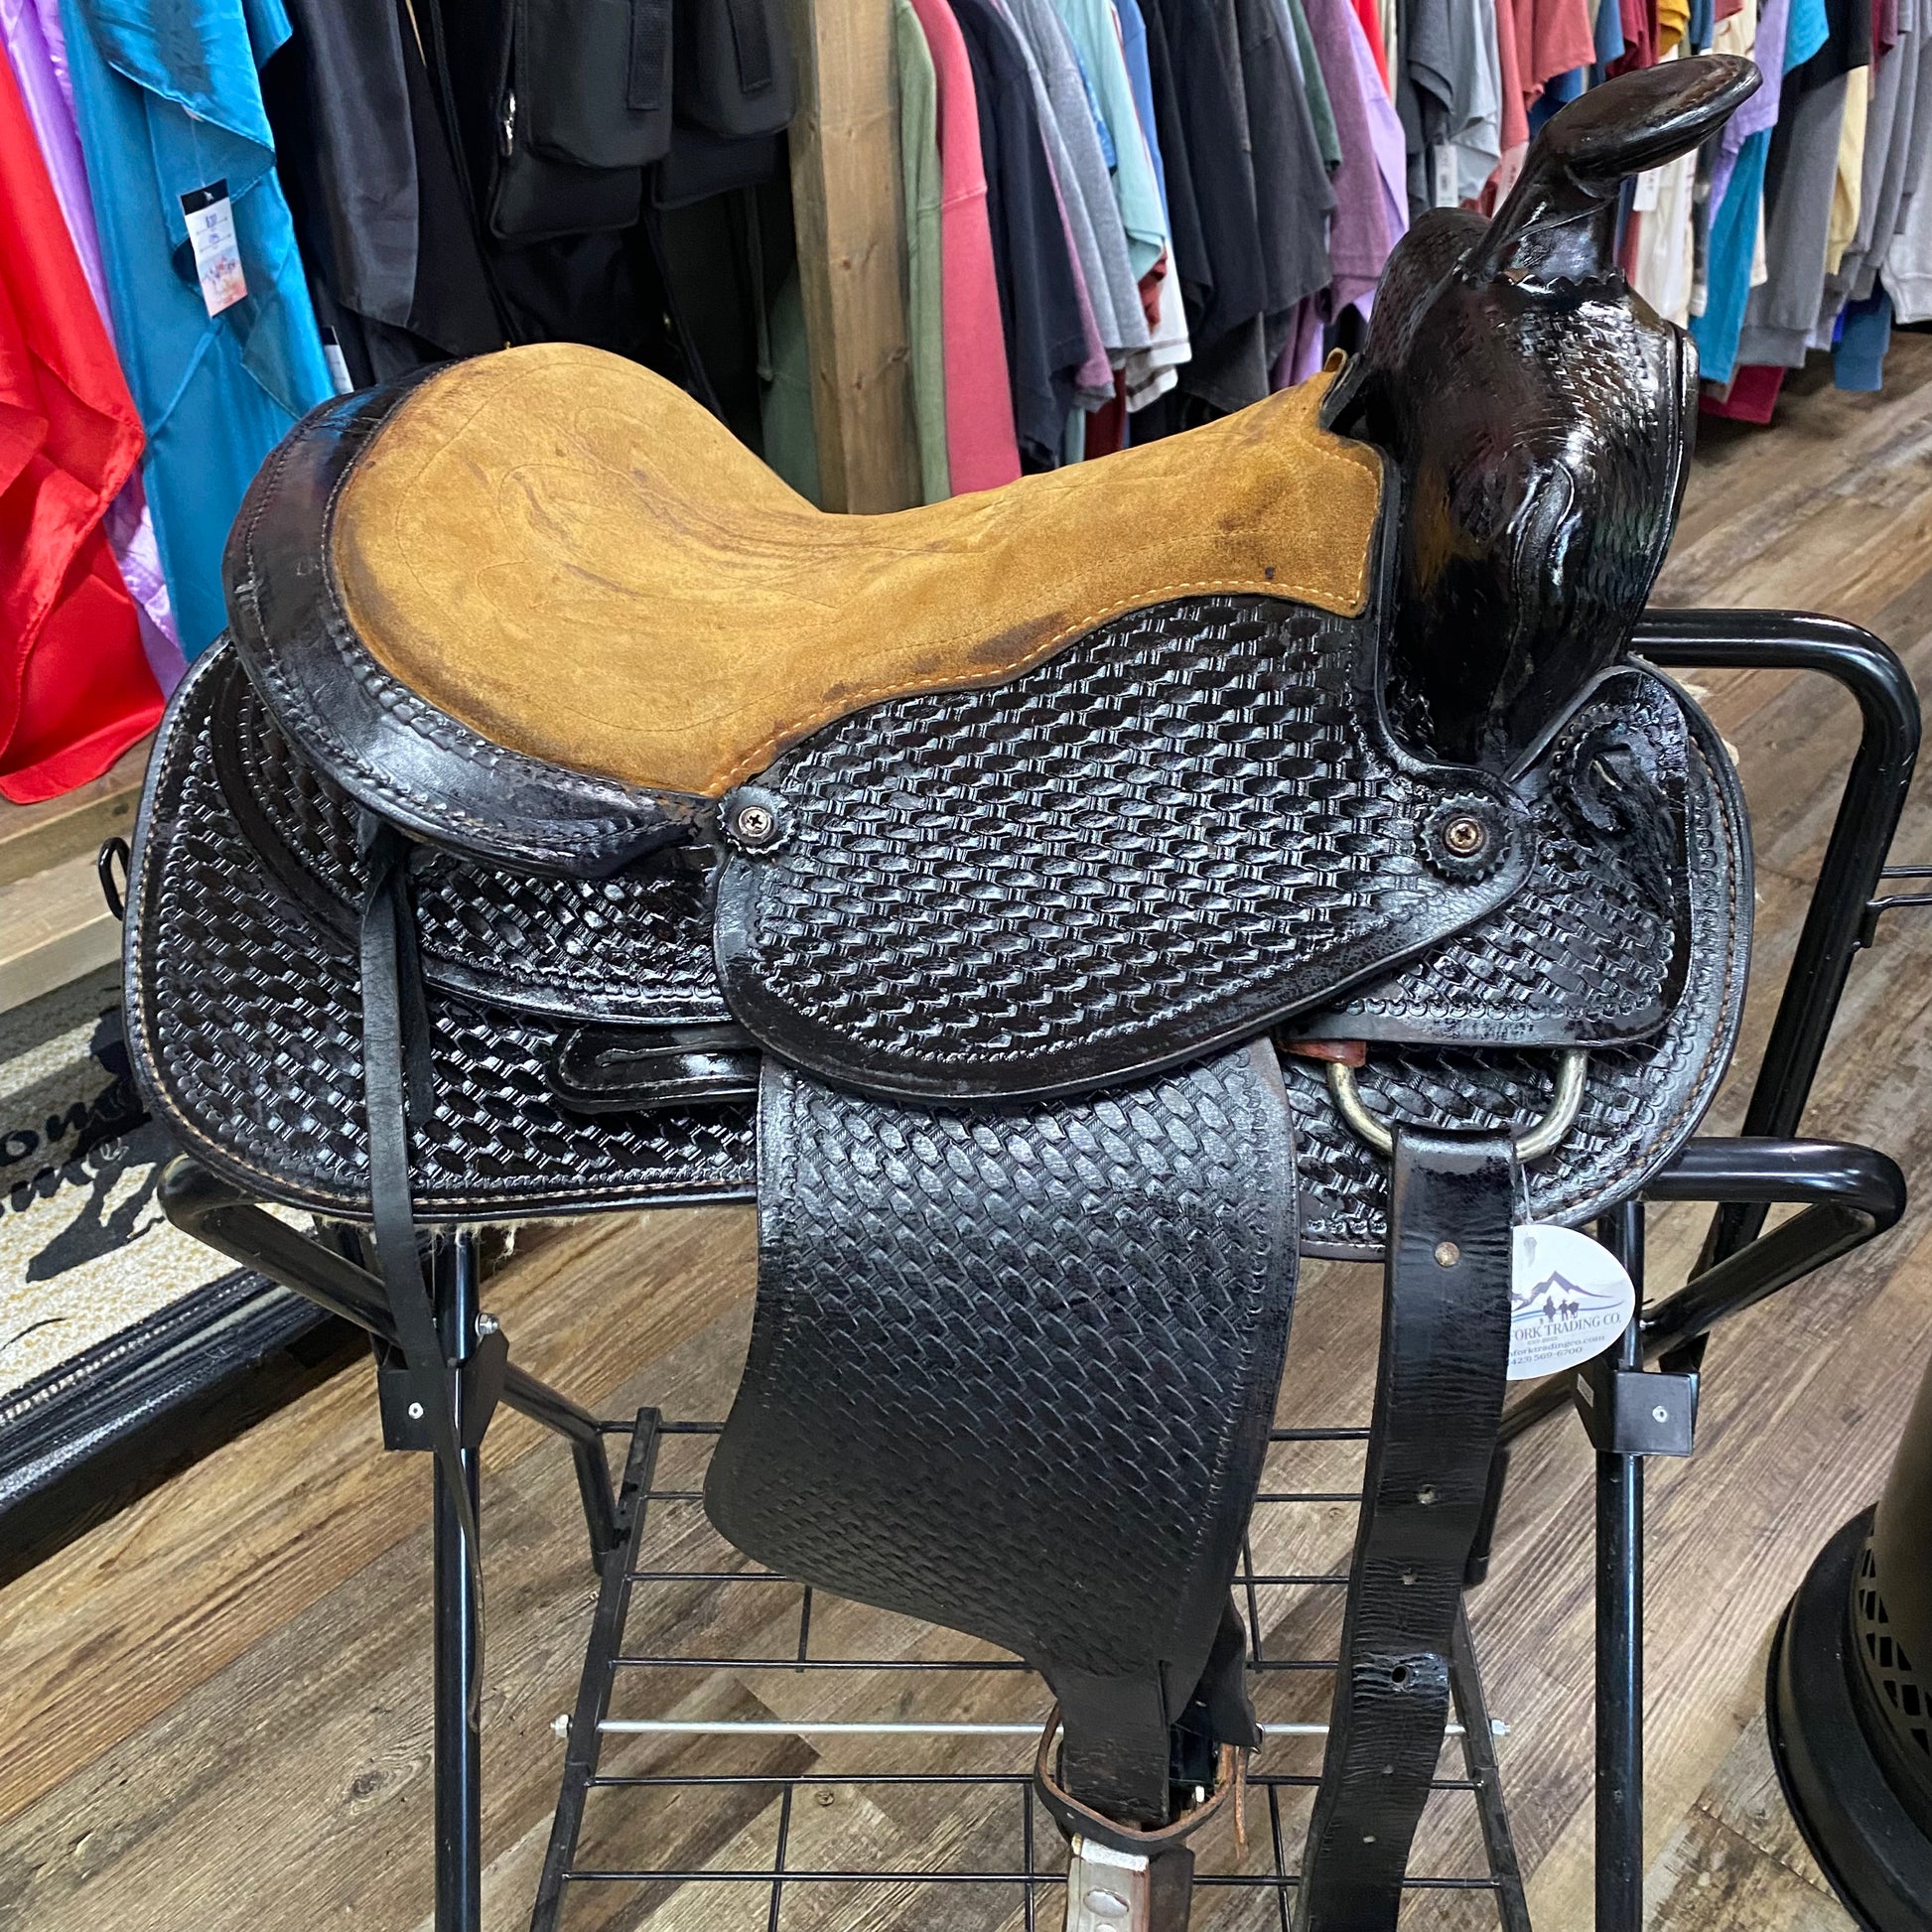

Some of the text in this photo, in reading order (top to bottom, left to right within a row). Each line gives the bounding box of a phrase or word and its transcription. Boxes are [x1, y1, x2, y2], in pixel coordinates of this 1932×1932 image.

[1512, 1326, 1542, 1341] ORK
[1544, 1316, 1600, 1336] TRADING
[1603, 1312, 1621, 1325] CO.
[1534, 1347, 1584, 1362] 569-6700
